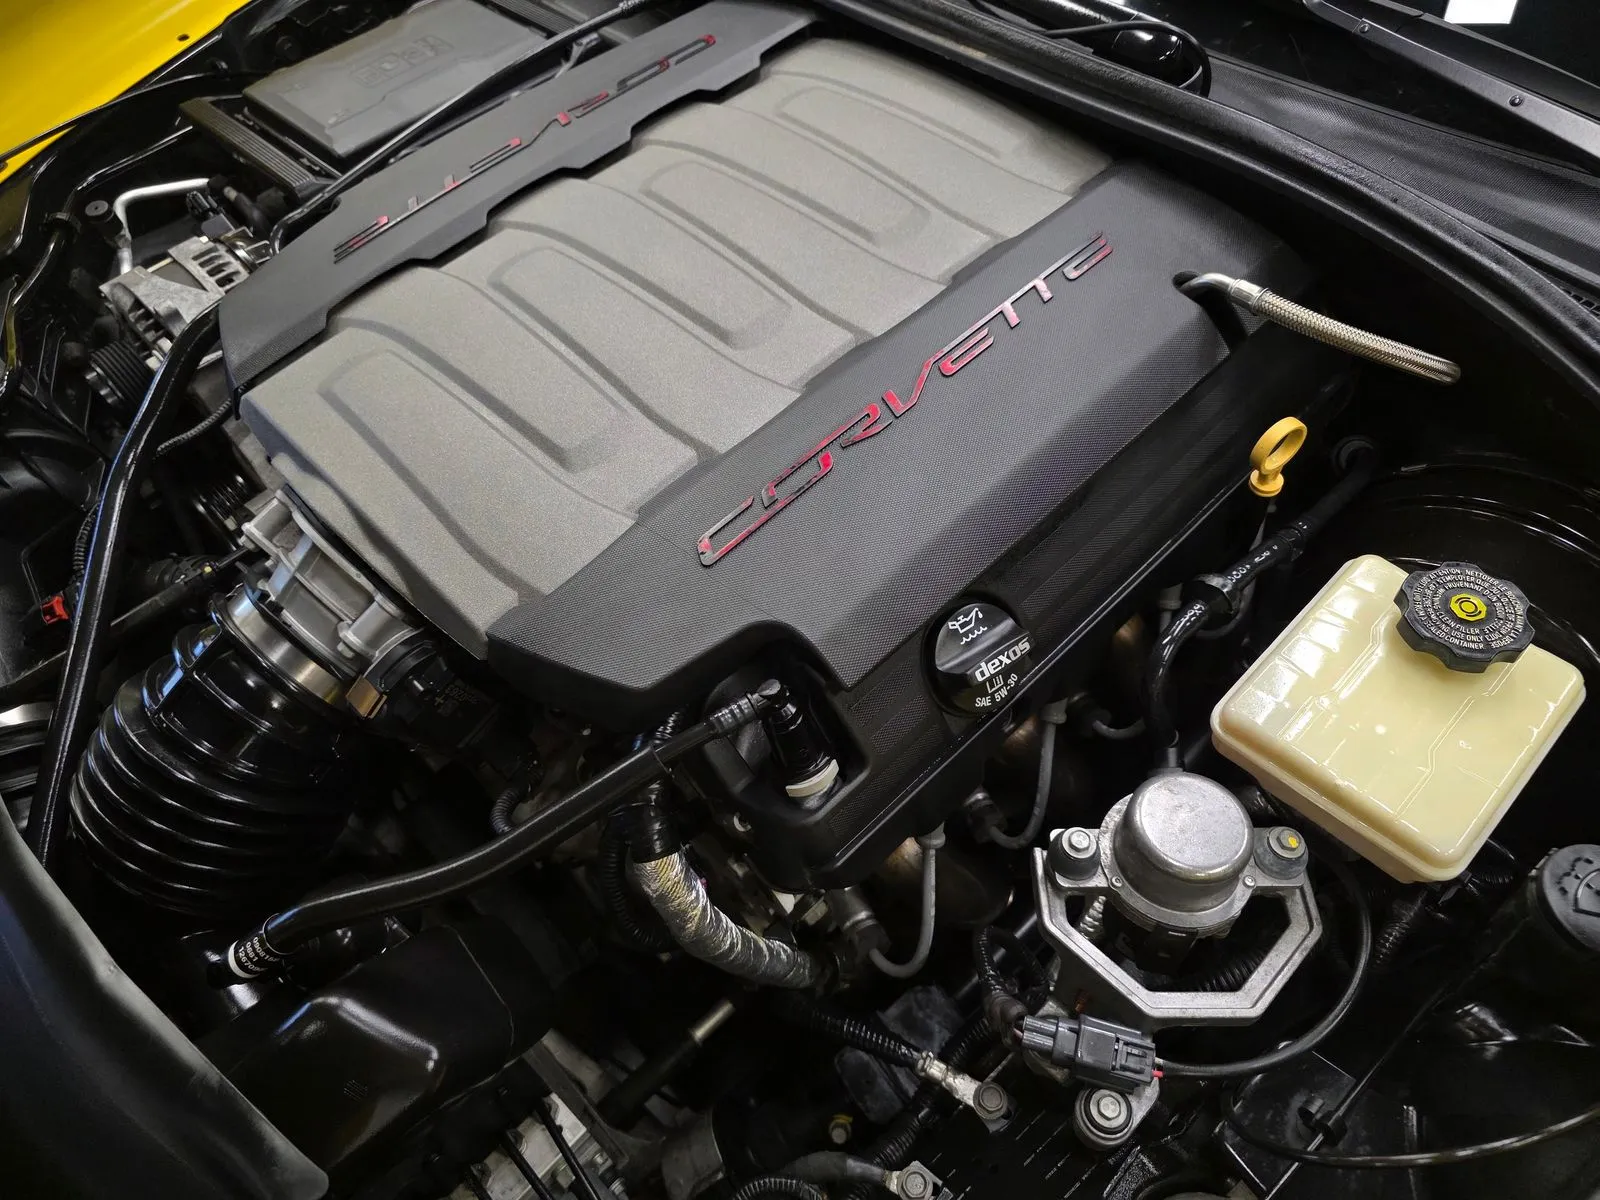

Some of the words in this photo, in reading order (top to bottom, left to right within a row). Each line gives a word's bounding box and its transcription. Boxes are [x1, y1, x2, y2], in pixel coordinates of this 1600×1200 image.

[697, 231, 1113, 567] CORVETTE
[1476, 579, 1491, 589] QUE
[1465, 569, 1499, 586] NETTOYER
[1497, 583, 1508, 592] LE
[1510, 629, 1520, 638] LA
[1424, 621, 1445, 638] SEALED
[1436, 611, 1456, 628] CLEAN
[1455, 624, 1480, 635] FILLER
[1451, 630, 1466, 640] USE
[1466, 633, 1484, 642] ONLY
[974, 636, 1031, 682] dexos
[975, 696, 992, 708] SAE
[994, 673, 1018, 702] 5W-30
